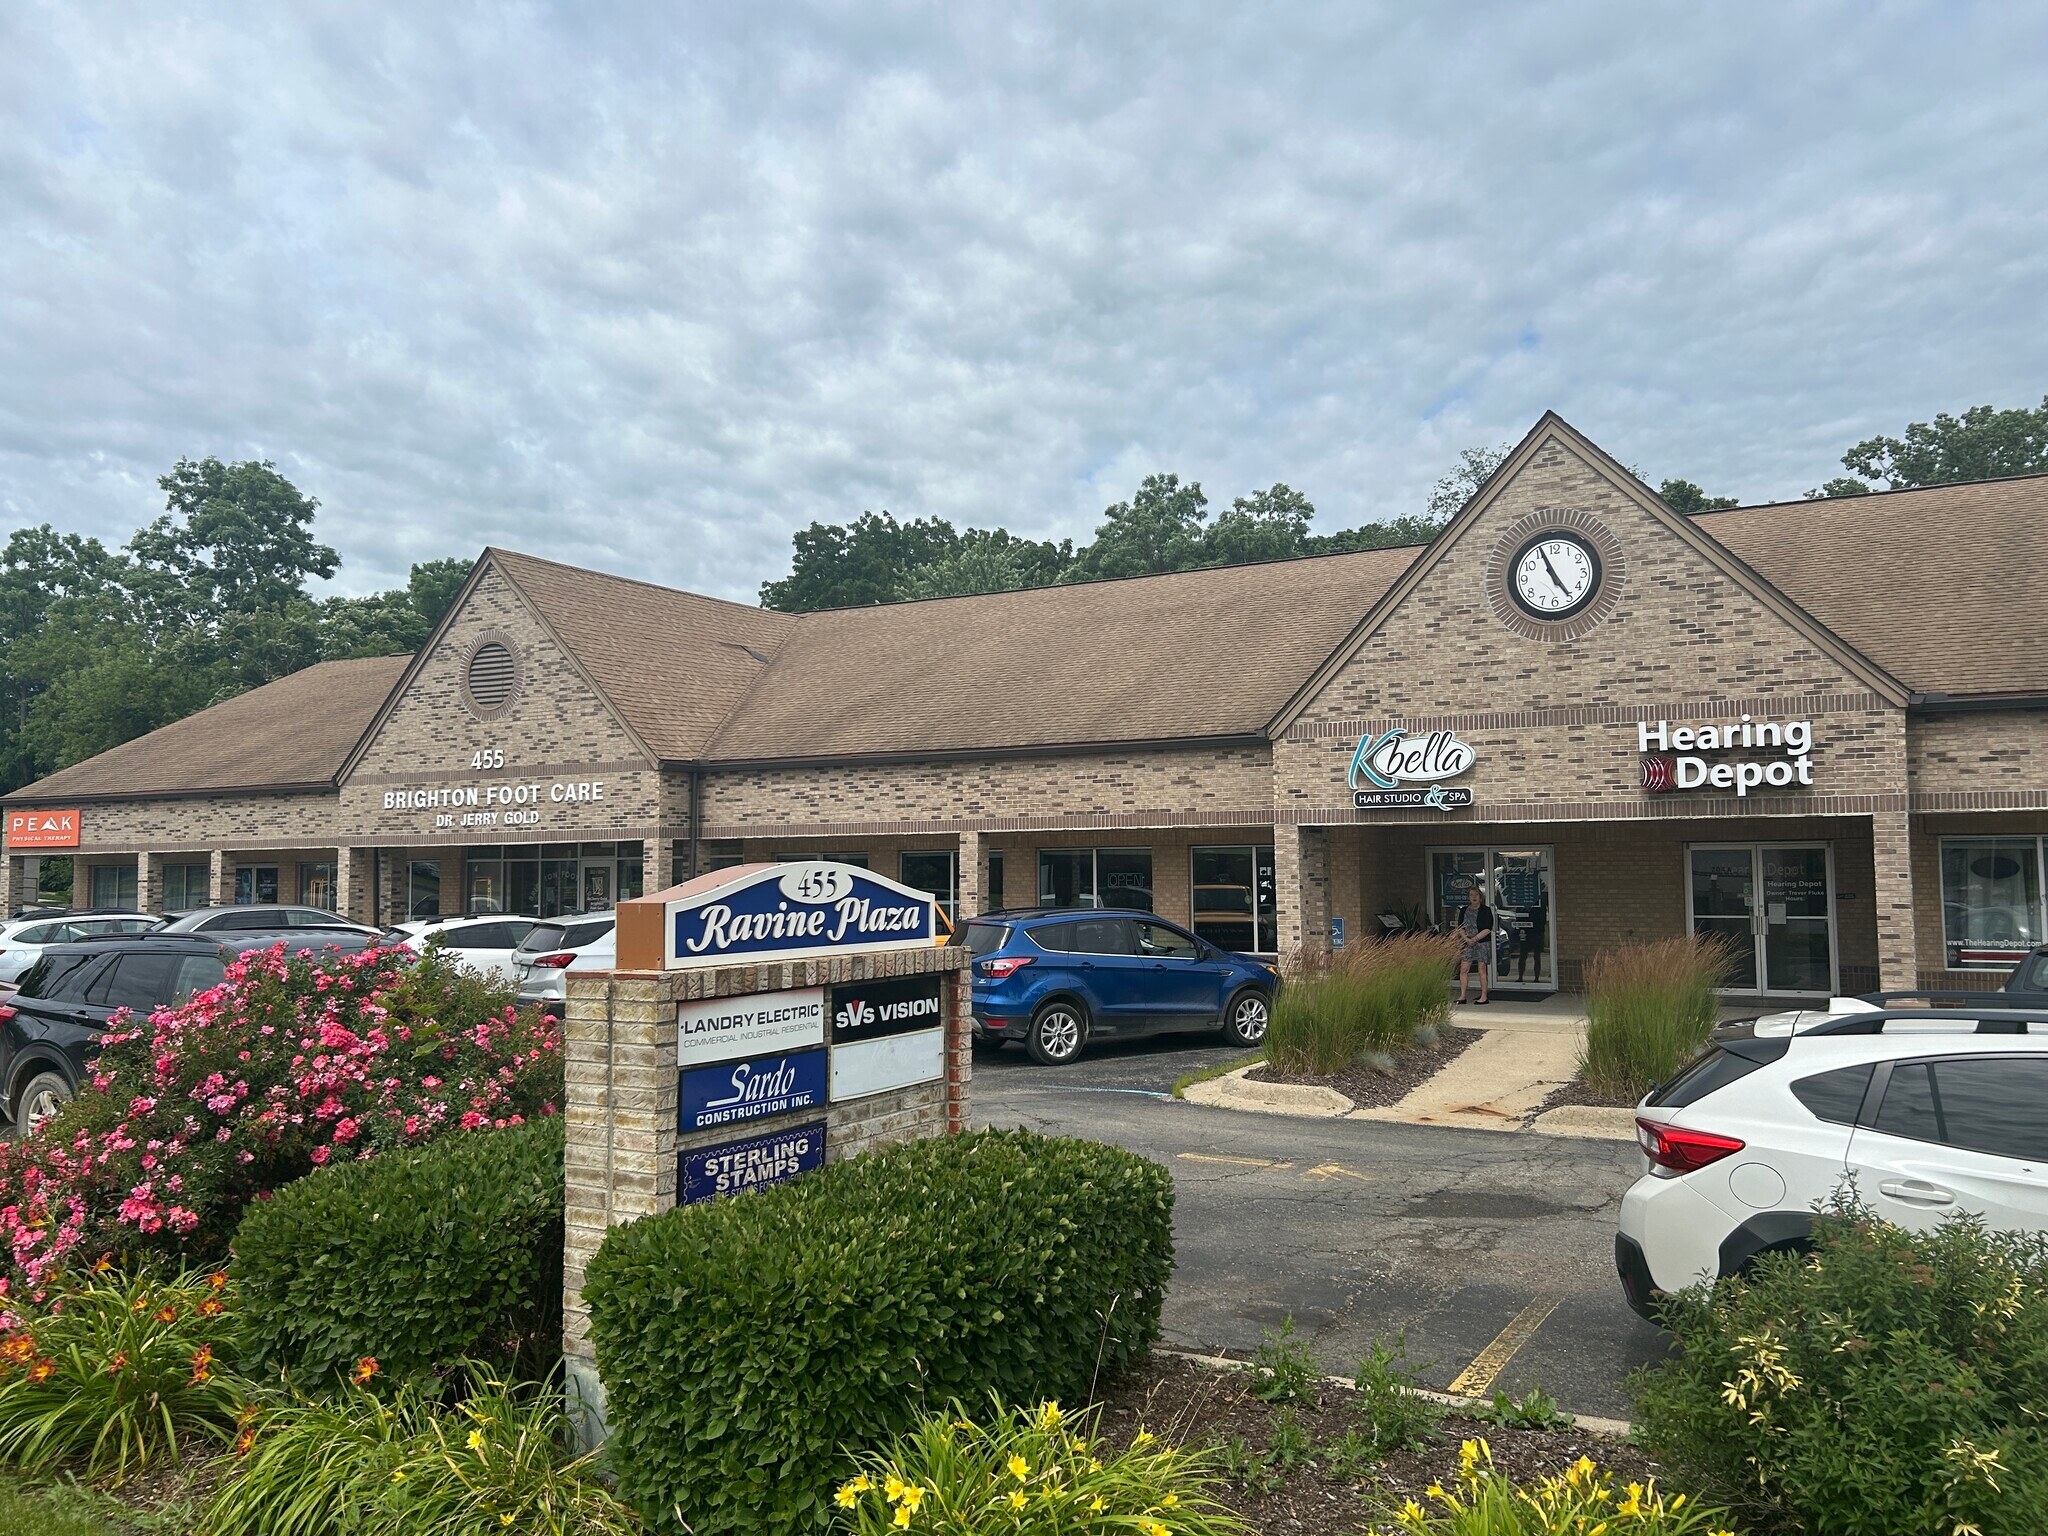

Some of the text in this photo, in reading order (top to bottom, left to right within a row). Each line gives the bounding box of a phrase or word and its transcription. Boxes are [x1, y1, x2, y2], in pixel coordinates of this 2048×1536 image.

[1550, 544, 1560, 554] 12
[1566, 546, 1570, 556] 1
[1525, 560, 1536, 571] 10
[1574, 554, 1582, 564] 2
[1521, 575, 1528, 585] 9
[1580, 568, 1587, 578] 3
[1528, 587, 1535, 598] 8
[1575, 580, 1582, 591] 4
[1539, 596, 1546, 606] 7
[1551, 597, 1559, 607] 6
[1566, 592, 1573, 602] 5
[1638, 714, 1812, 756] Hearing
[470, 750, 504, 770] 455
[1676, 755, 1813, 796] Depot
[384, 782, 604, 809] BRIGHTON FOOT CARE
[1359, 784, 1467, 811] HAIR STUDIO & SPA
[13, 816, 72, 832] PEAK
[436, 811, 539, 827] DR. JERRY GOLD
[798, 870, 837, 898] 455
[1110, 874, 1142, 886] OPEN
[686, 896, 920, 952] Ravine Plaza
[1947, 939, 2042, 948] www.TheHearingDepot.com
[879, 998, 938, 1021] VISION
[684, 1004, 819, 1034] LANDRY ELECTRIC
[684, 1022, 819, 1048] COMMERCIAL INDUSTRIAL RESIDENTIAL
[706, 1058, 795, 1108] Sardo
[696, 1095, 814, 1126] CONSTRUCTION INC.
[705, 1138, 808, 1176] STERLING
[716, 1156, 799, 1190] STAMPS
